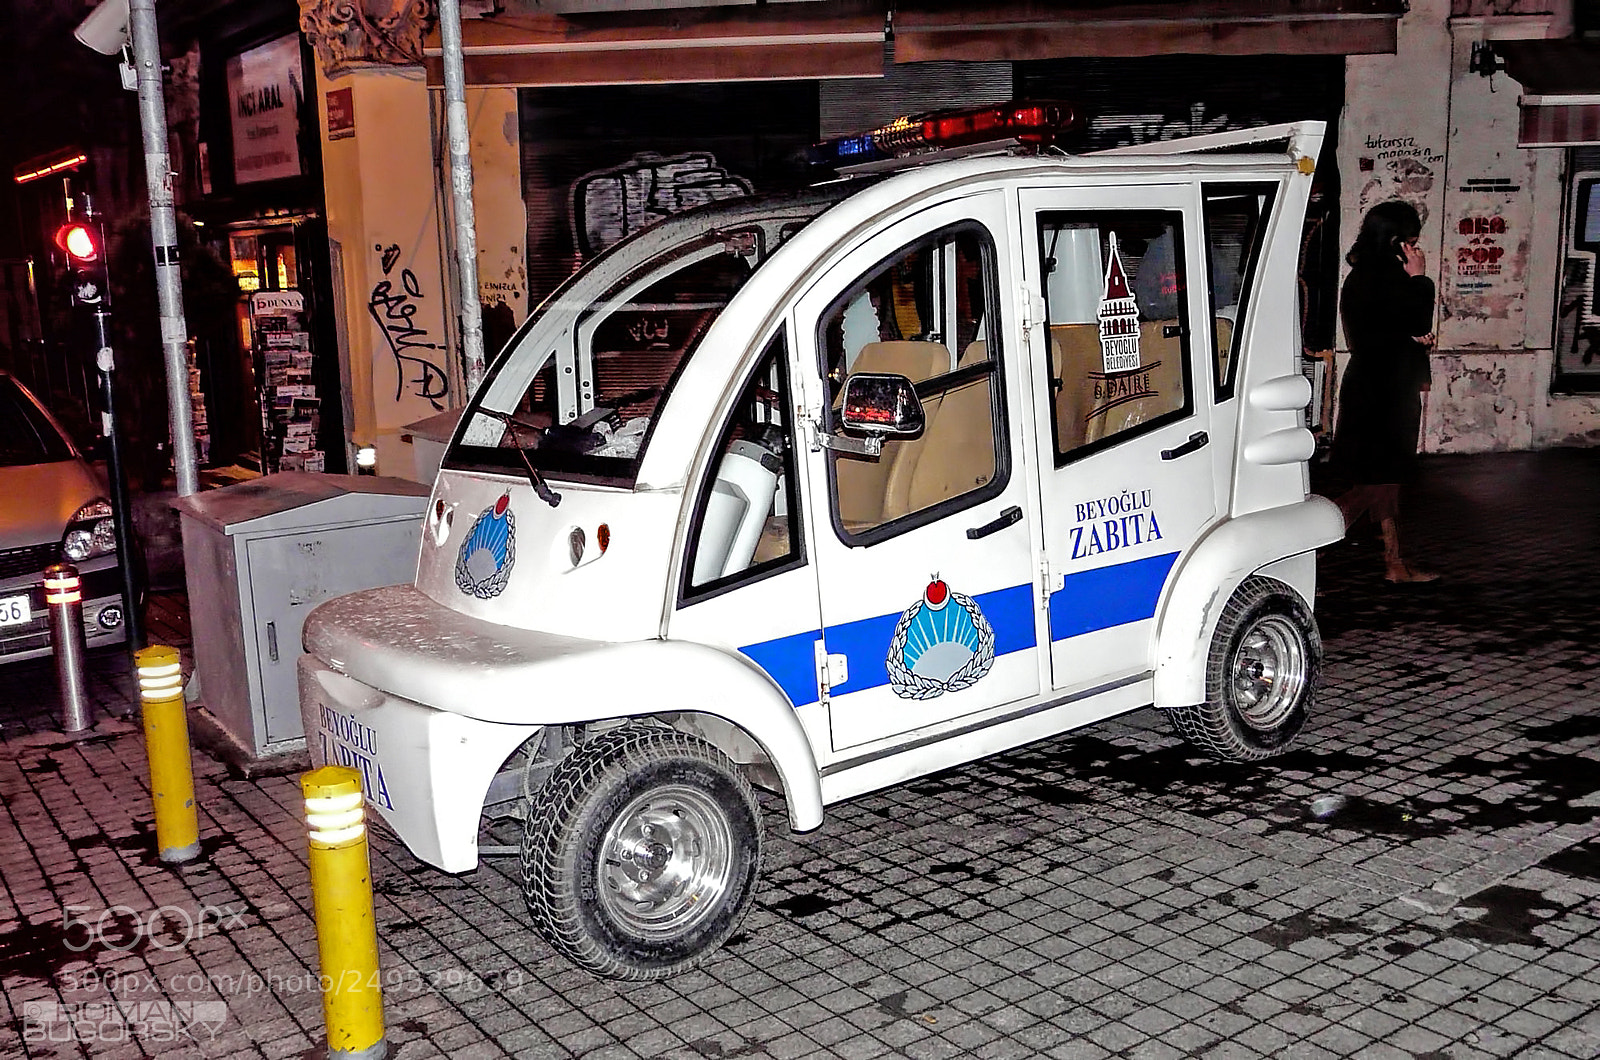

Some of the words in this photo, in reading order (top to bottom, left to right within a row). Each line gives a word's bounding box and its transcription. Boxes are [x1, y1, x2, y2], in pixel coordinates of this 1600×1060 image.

[1104, 336, 1137, 357] BEYOĞLU
[1074, 488, 1152, 522] BEYOĞLU
[1069, 510, 1163, 560] ZABITA
[318, 702, 377, 755] BEYOĞLU
